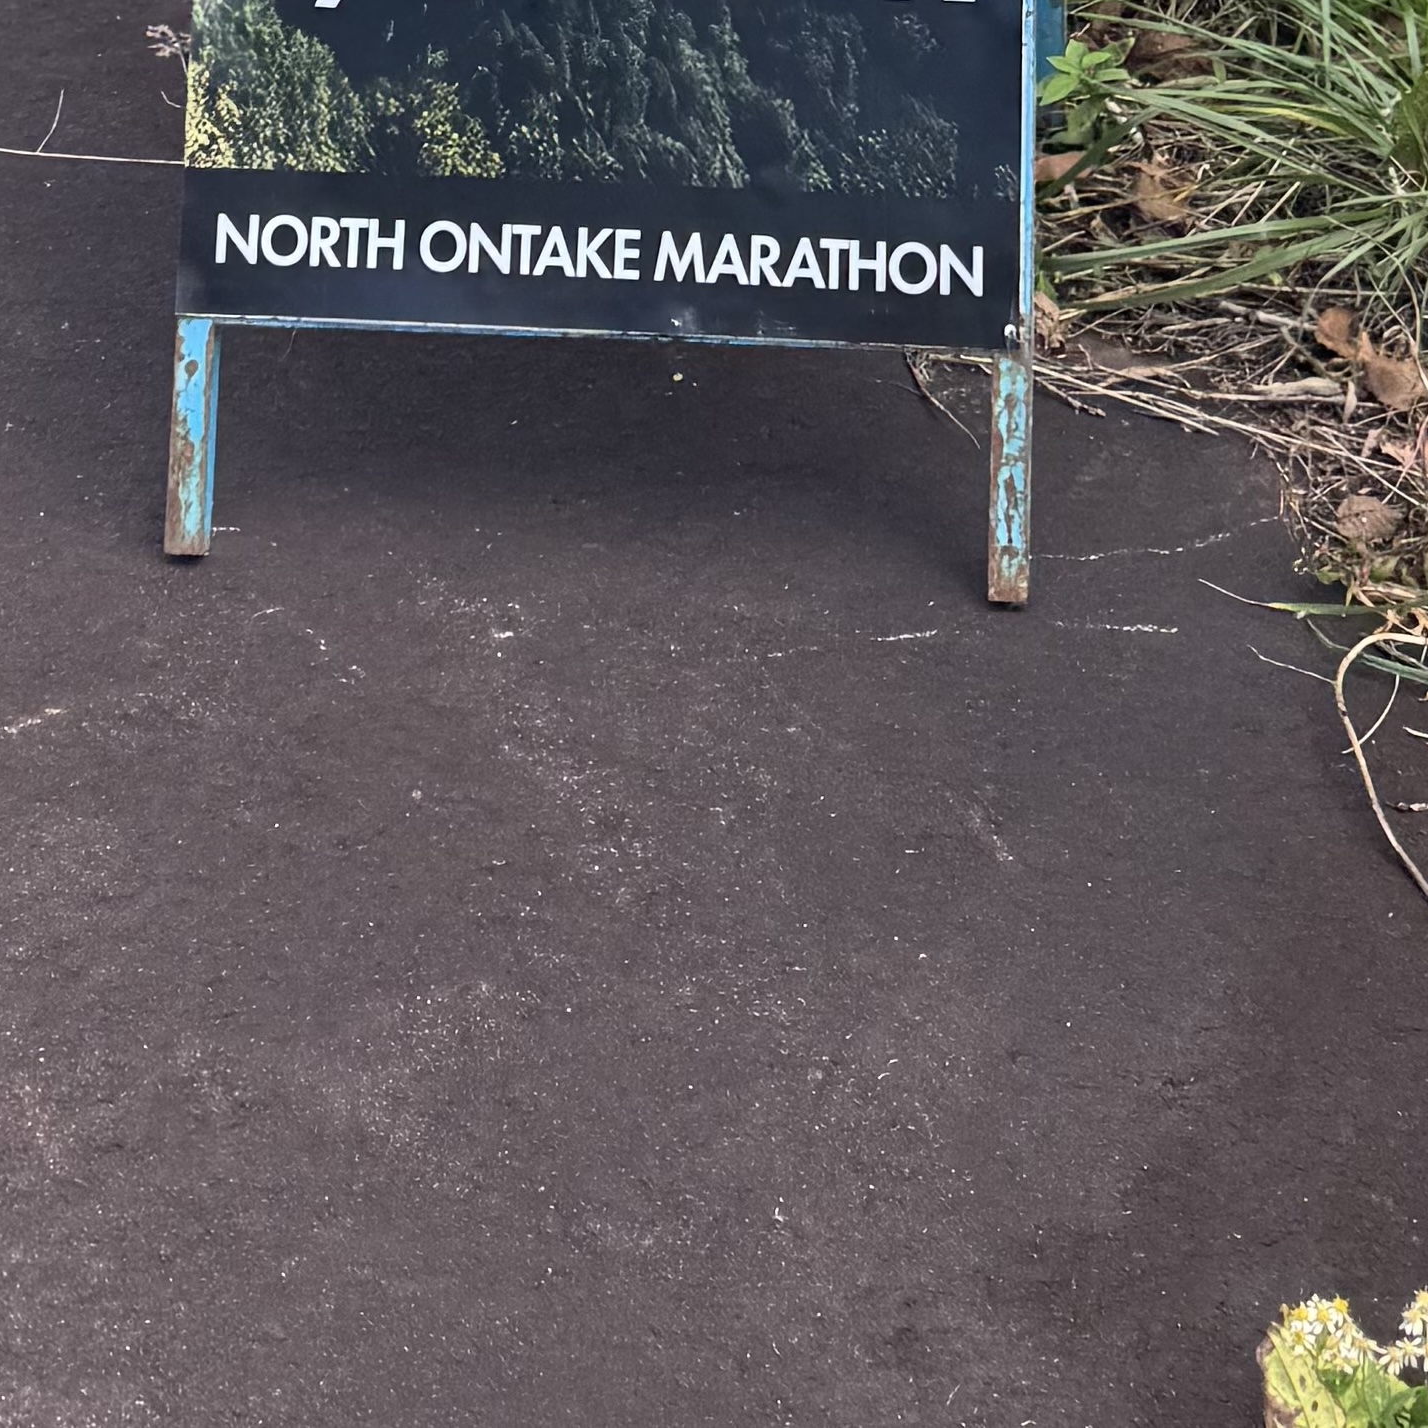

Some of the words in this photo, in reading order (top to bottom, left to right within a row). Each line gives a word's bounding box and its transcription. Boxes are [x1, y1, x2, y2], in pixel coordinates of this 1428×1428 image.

[214, 211, 406, 272] NORTH
[418, 218, 642, 282] ONTAKE
[653, 230, 985, 297] MARATHON
